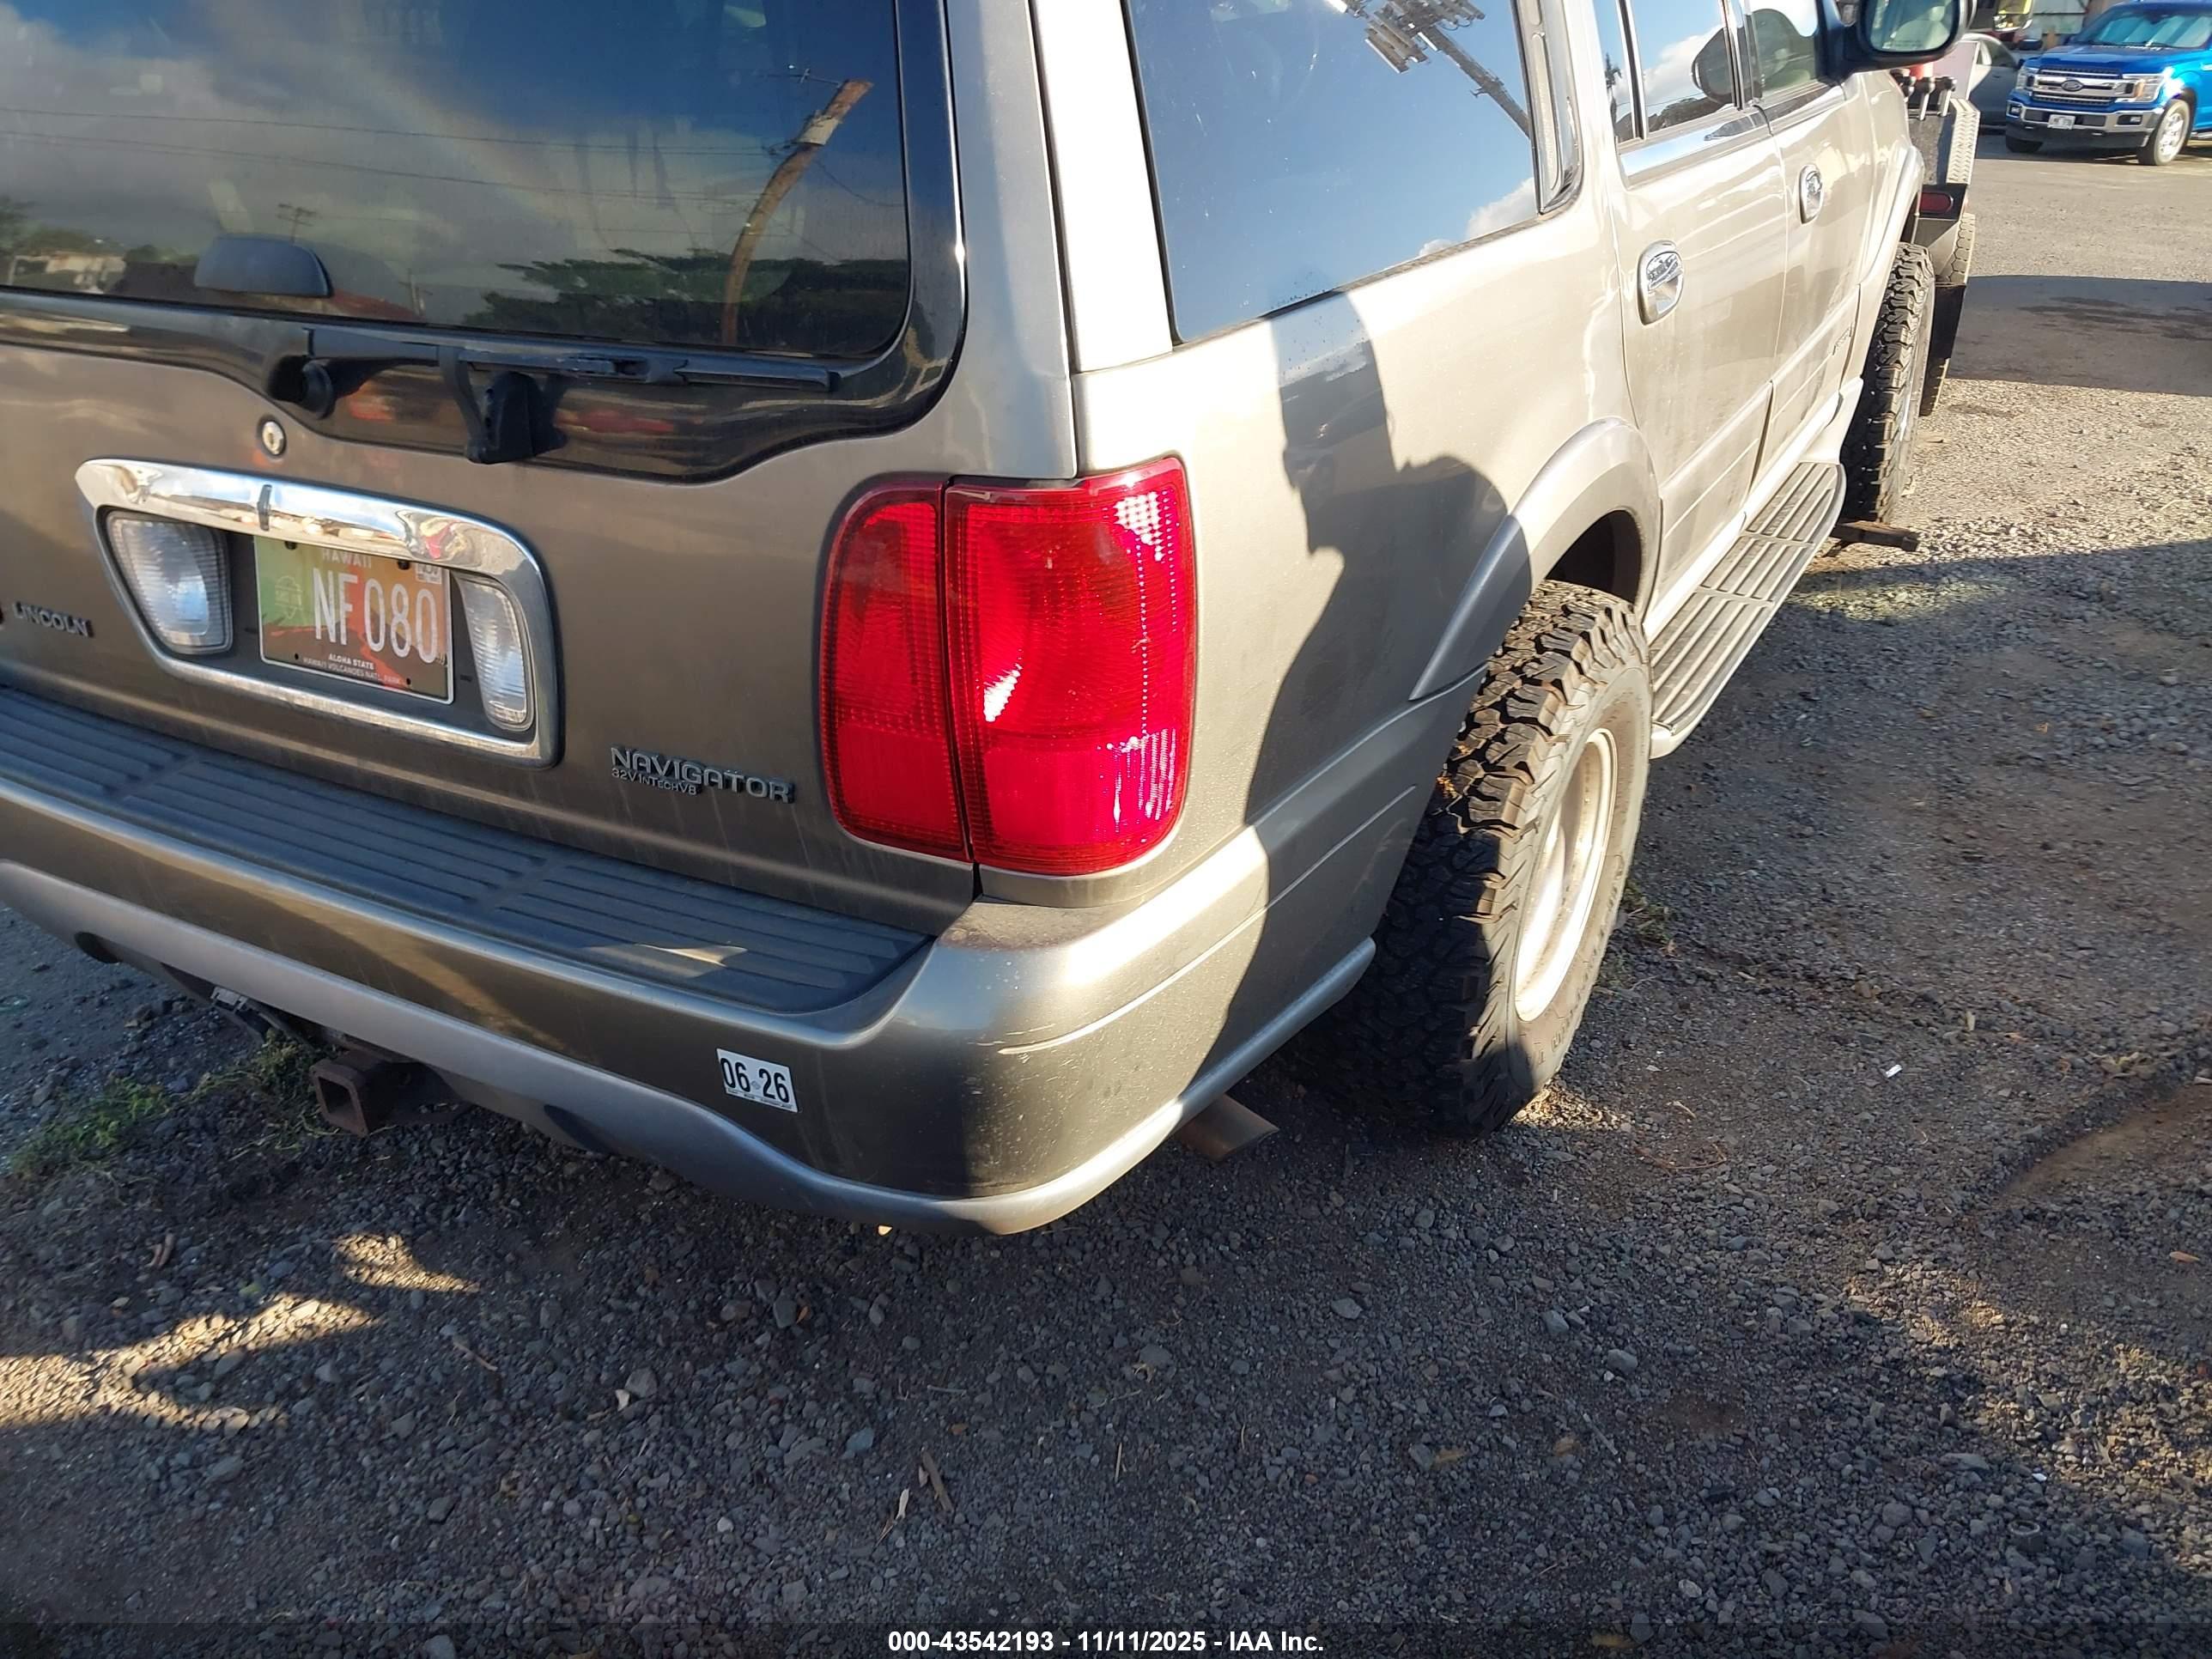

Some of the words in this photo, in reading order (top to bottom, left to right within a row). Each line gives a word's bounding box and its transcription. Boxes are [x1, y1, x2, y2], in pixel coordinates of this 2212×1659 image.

[322, 550, 372, 568] HAWAII
[12, 603, 89, 637] LINCOLN
[313, 568, 358, 646] NF
[363, 578, 438, 664] 080
[328, 653, 352, 665] ALOHA
[352, 659, 374, 670] STATE
[611, 746, 792, 803] NAVIGATOR
[720, 1057, 751, 1092] 06
[759, 1068, 790, 1103] 26
